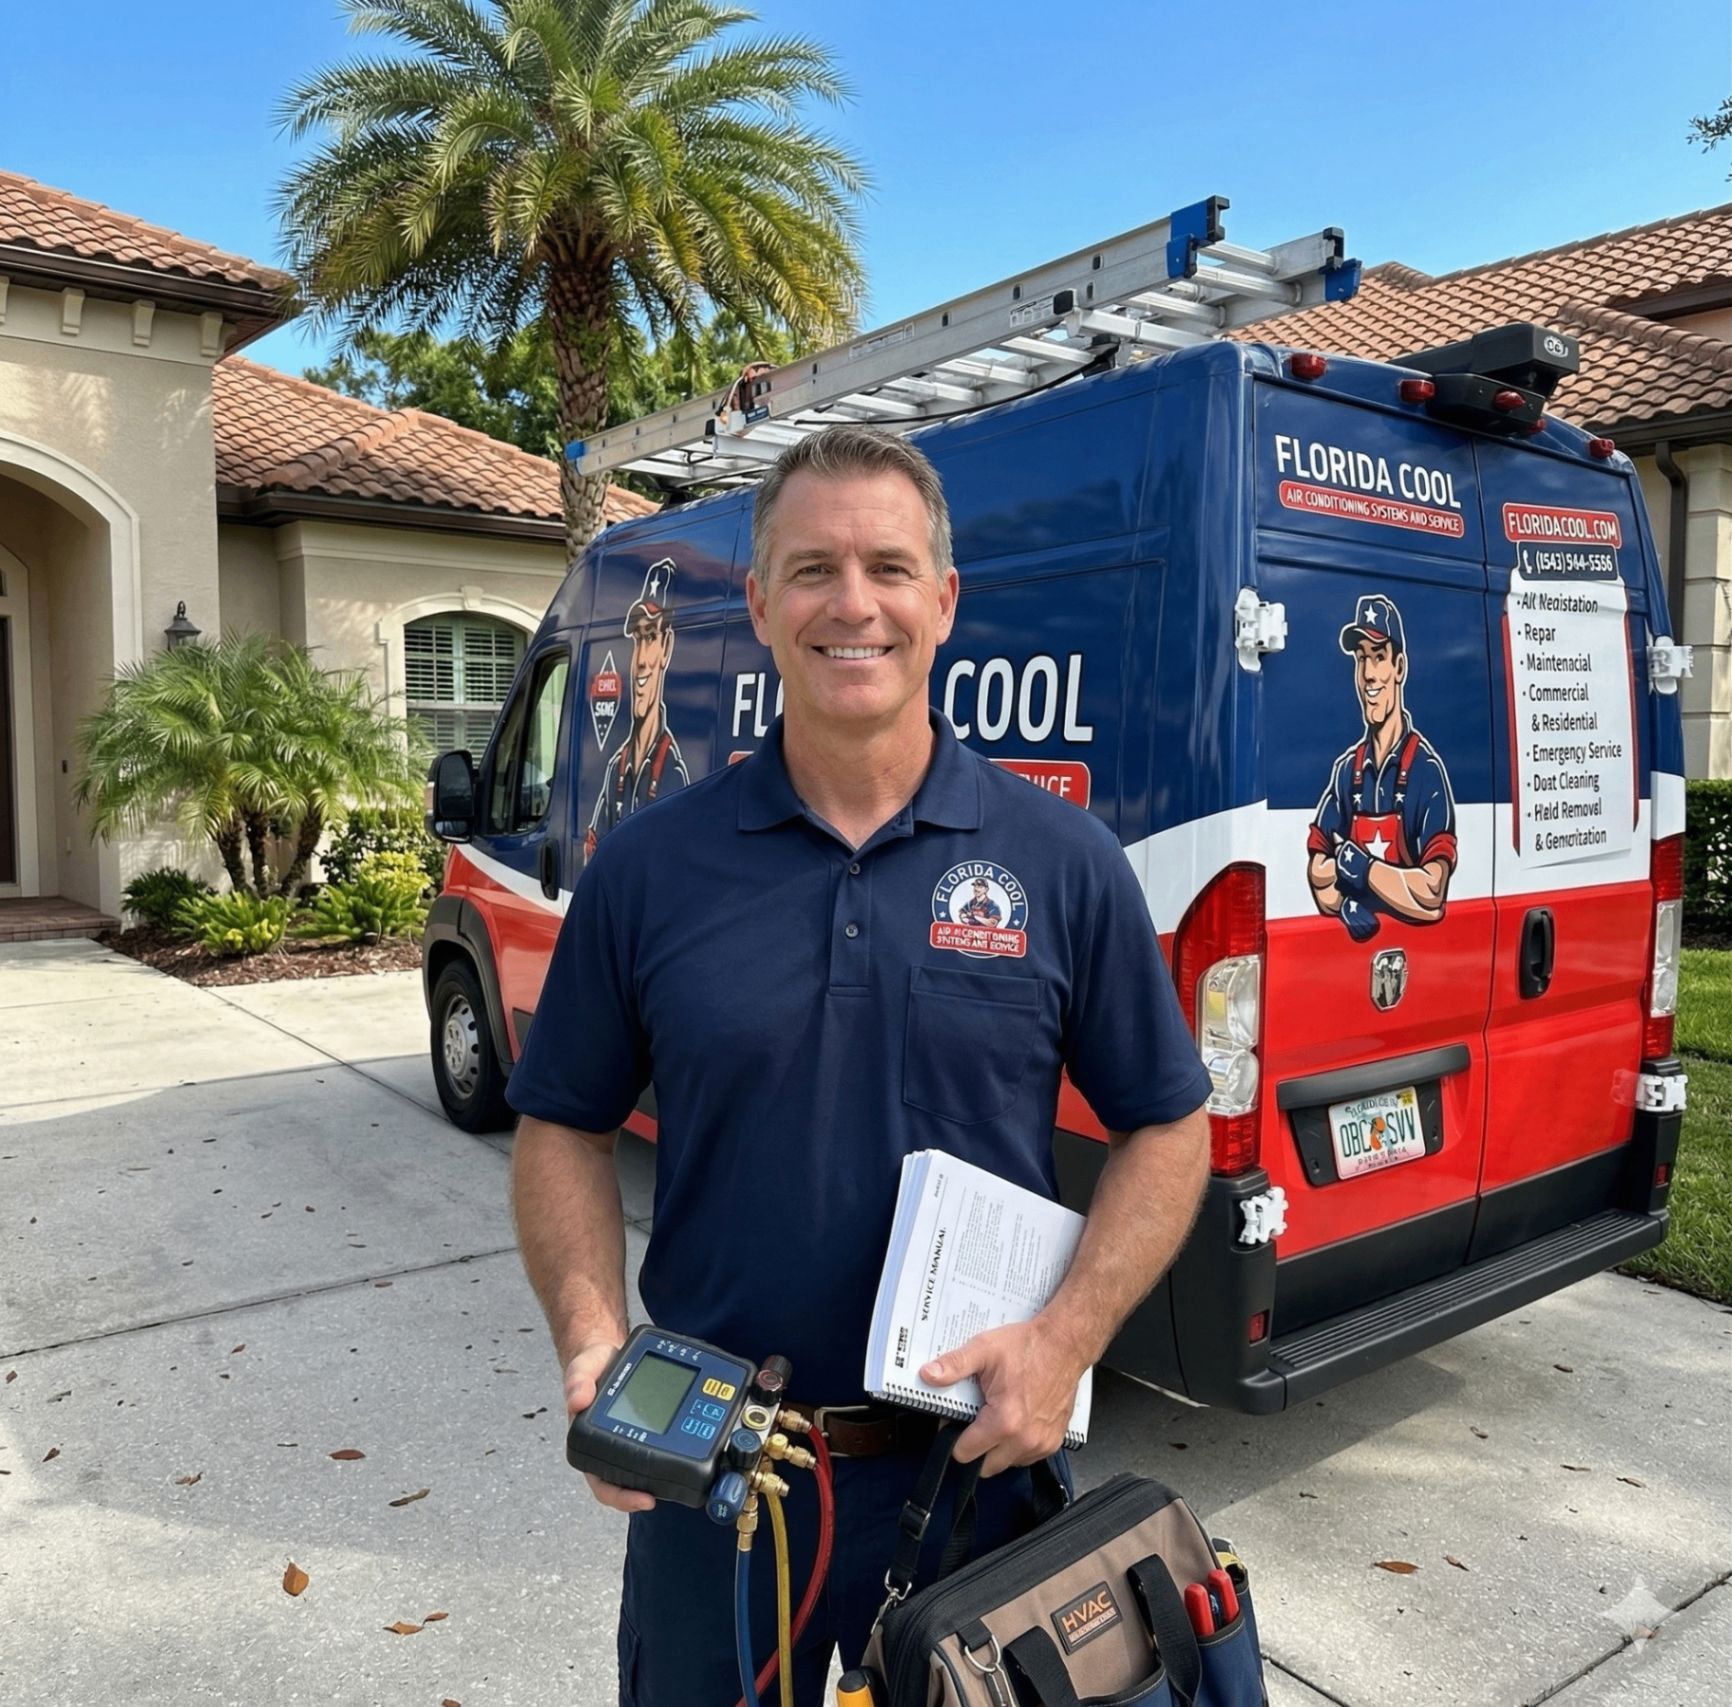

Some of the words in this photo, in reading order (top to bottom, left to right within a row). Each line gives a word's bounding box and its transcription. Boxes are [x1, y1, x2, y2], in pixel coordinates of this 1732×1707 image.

[1275, 435, 1394, 495] FLORIDA
[1399, 463, 1461, 509] COOL
[1286, 488, 1303, 504] AIR
[1305, 491, 1370, 516] CONDITIONING
[1508, 512, 1618, 540] FLORIDACOOL.COM
[1524, 623, 1556, 645] Repar
[943, 654, 1093, 742] COOL
[1529, 682, 1589, 702] Commercial
[1531, 713, 1540, 732] &
[1542, 712, 1598, 731] Residential
[1532, 744, 1586, 766] Emergency
[1588, 740, 1622, 759] Service
[1559, 770, 1600, 793] Cleaning
[1535, 833, 1544, 851] &
[936, 864, 994, 903] FLORIDA
[998, 873, 1024, 911] COOL
[921, 1277, 936, 1321] SERVICE
[930, 1227, 946, 1275] MANUAL
[1061, 1590, 1111, 1633] HVAC
